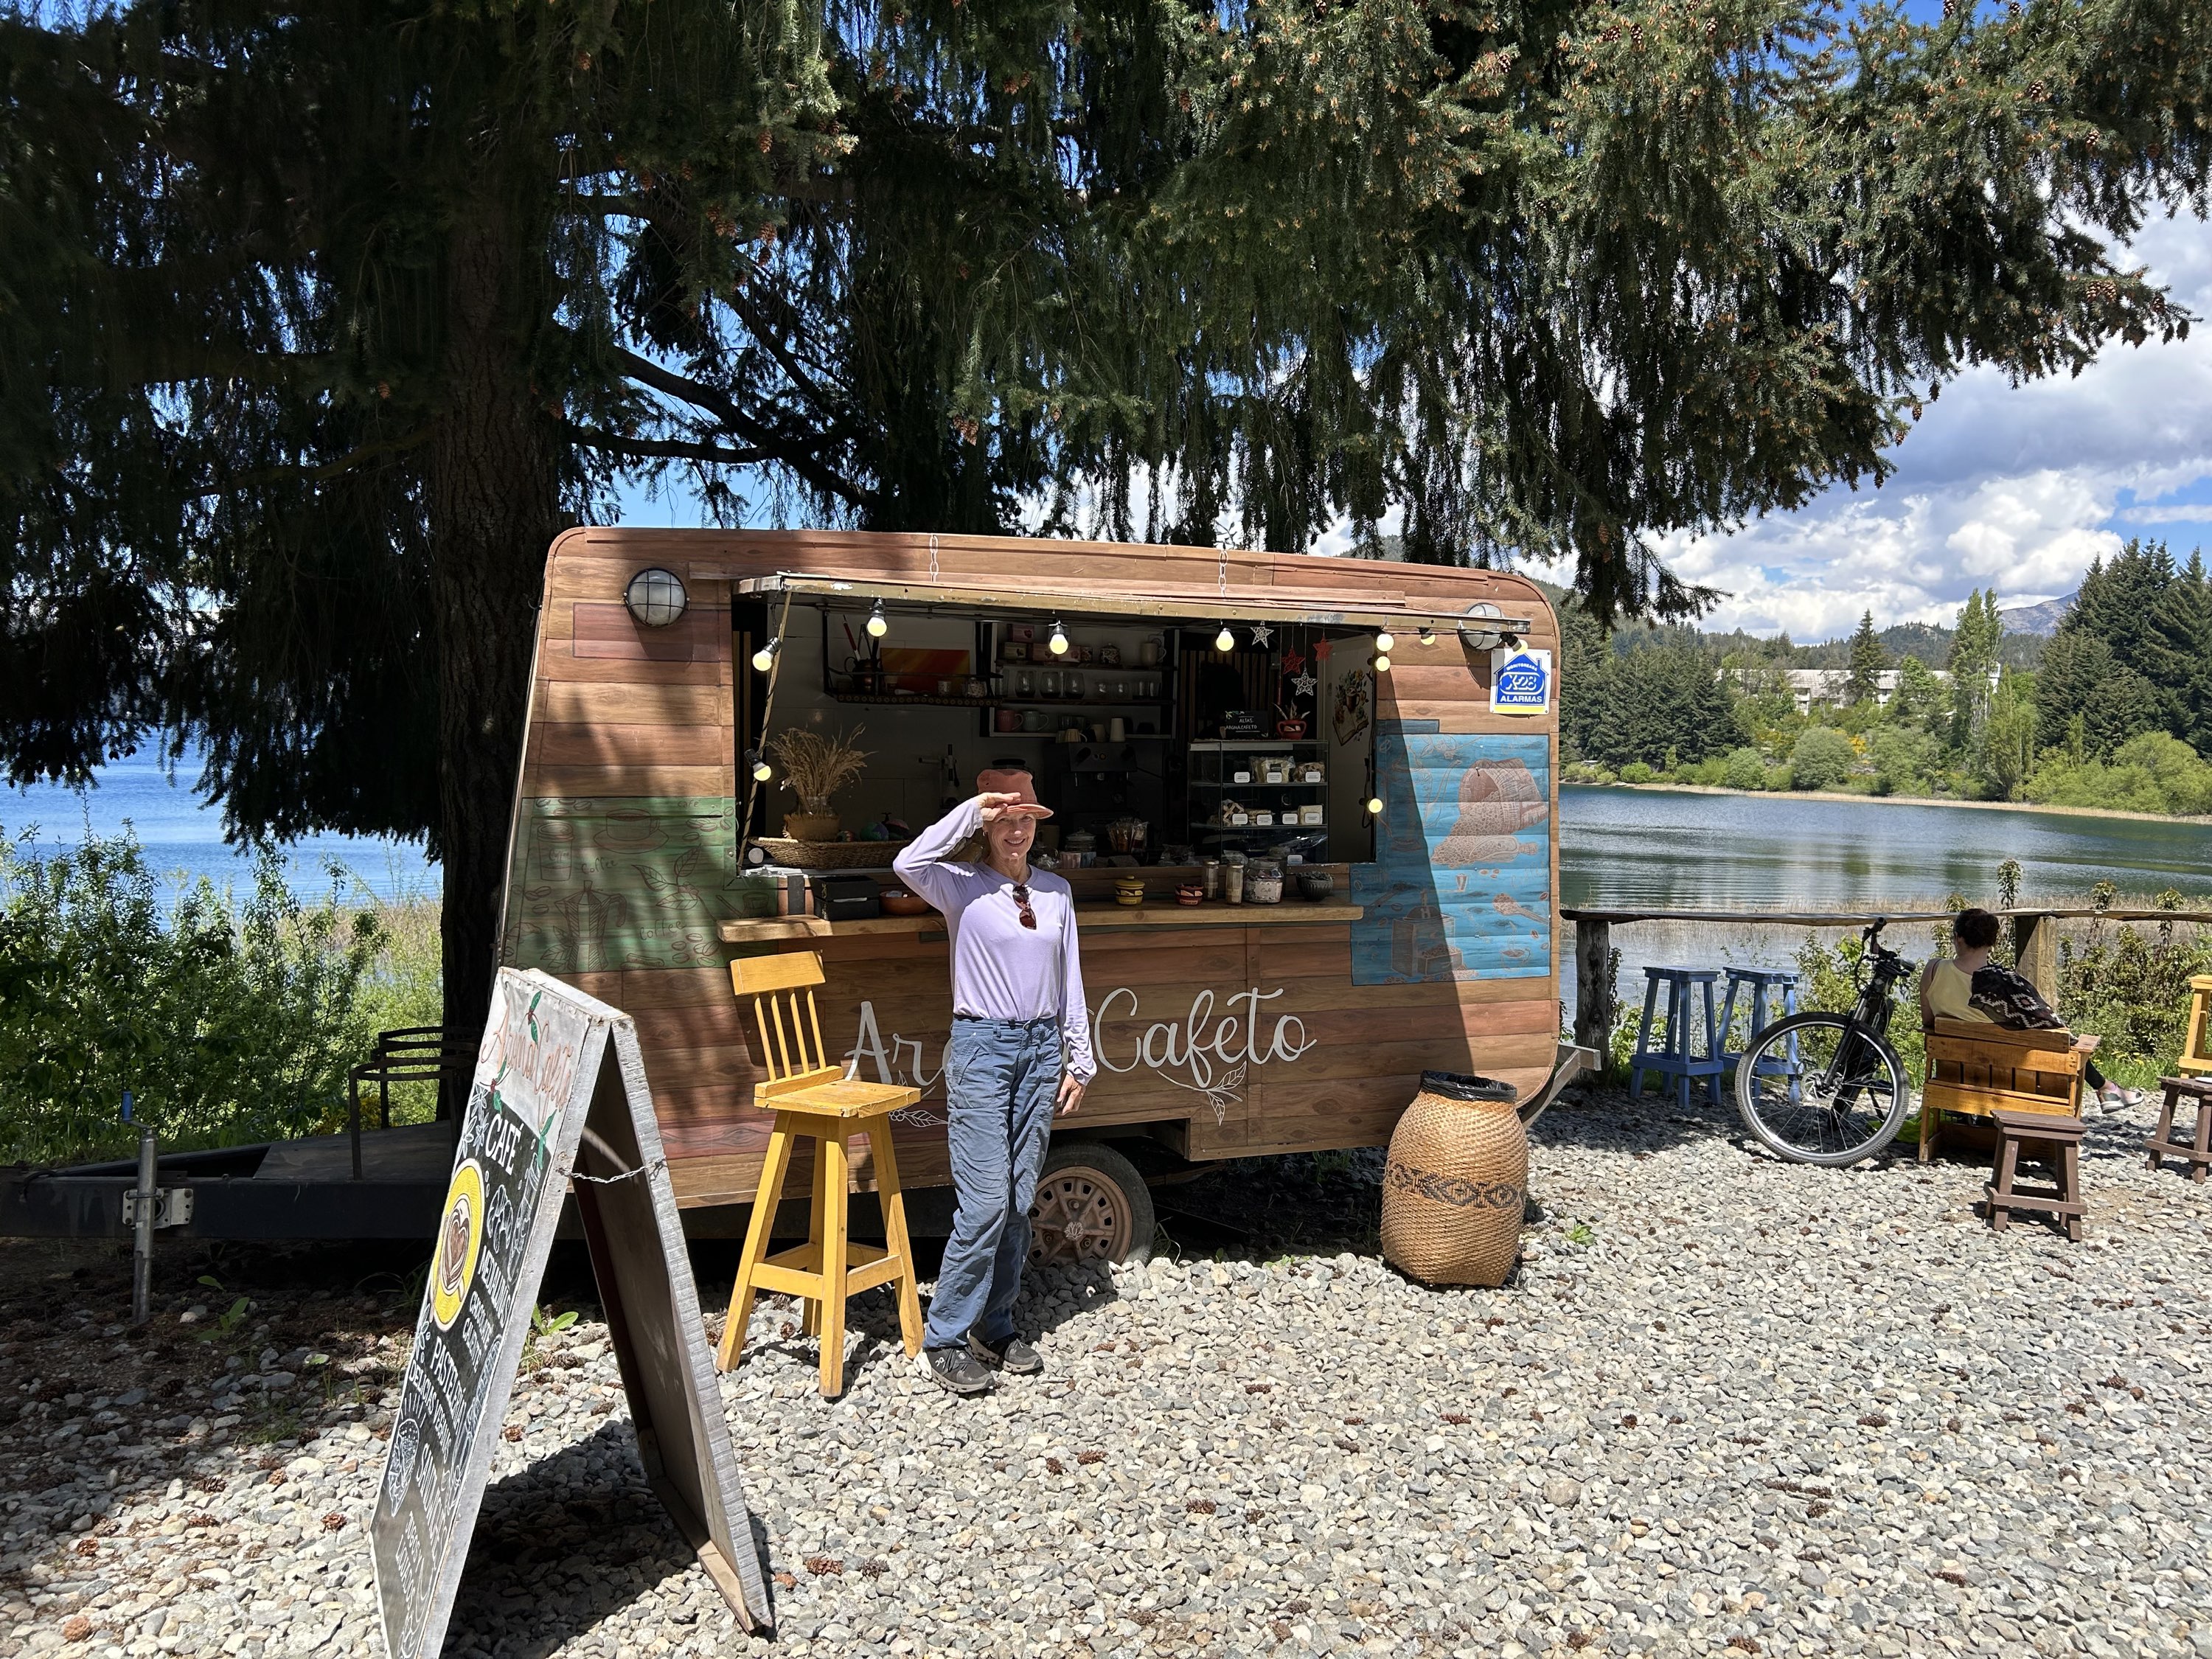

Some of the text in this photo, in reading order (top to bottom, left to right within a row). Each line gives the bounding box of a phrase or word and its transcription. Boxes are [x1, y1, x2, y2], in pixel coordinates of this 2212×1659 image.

[1094, 987, 1318, 1088] Cafeto
[484, 1113, 524, 1176] CAFÉ
[469, 1290, 493, 1351] CHOCOLATE
[478, 1245, 512, 1329] MEDIALUNAS
[430, 1335, 466, 1436] PASTELERÍA
[462, 1317, 482, 1374] CALIENTE
[408, 1359, 451, 1464] DELICIAS VEGANAS
[405, 1509, 420, 1562] JUGOS
[416, 1443, 448, 1571] SANDWICHES
[395, 1534, 415, 1612] LICUADOS
